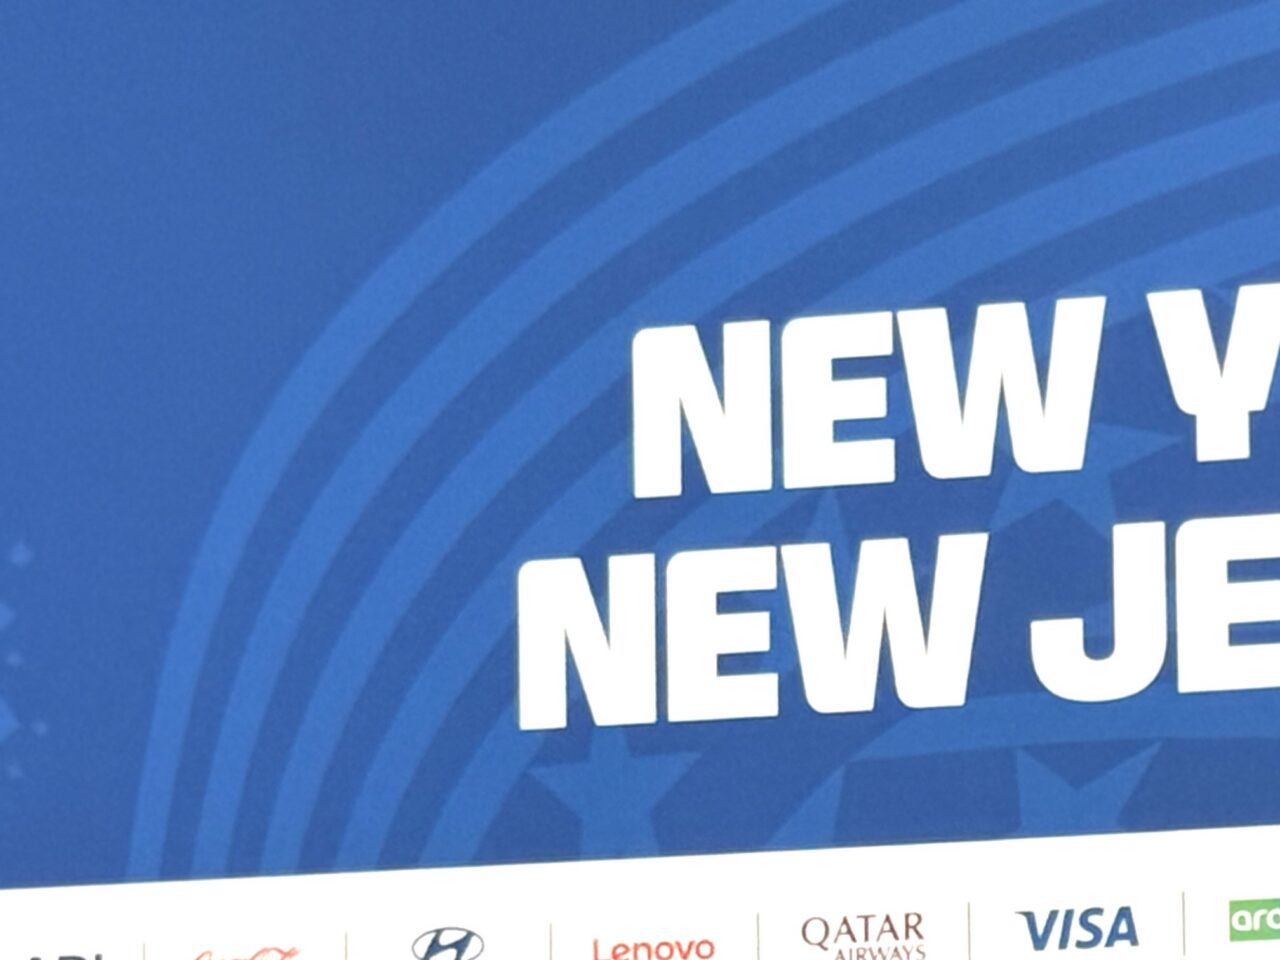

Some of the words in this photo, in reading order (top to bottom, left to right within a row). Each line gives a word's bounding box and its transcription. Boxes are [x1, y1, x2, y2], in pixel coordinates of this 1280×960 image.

[630, 296, 1107, 500] NEW
[517, 532, 989, 732] NEW
[800, 911, 925, 949] QATAR
[1015, 905, 1140, 952] VISA
